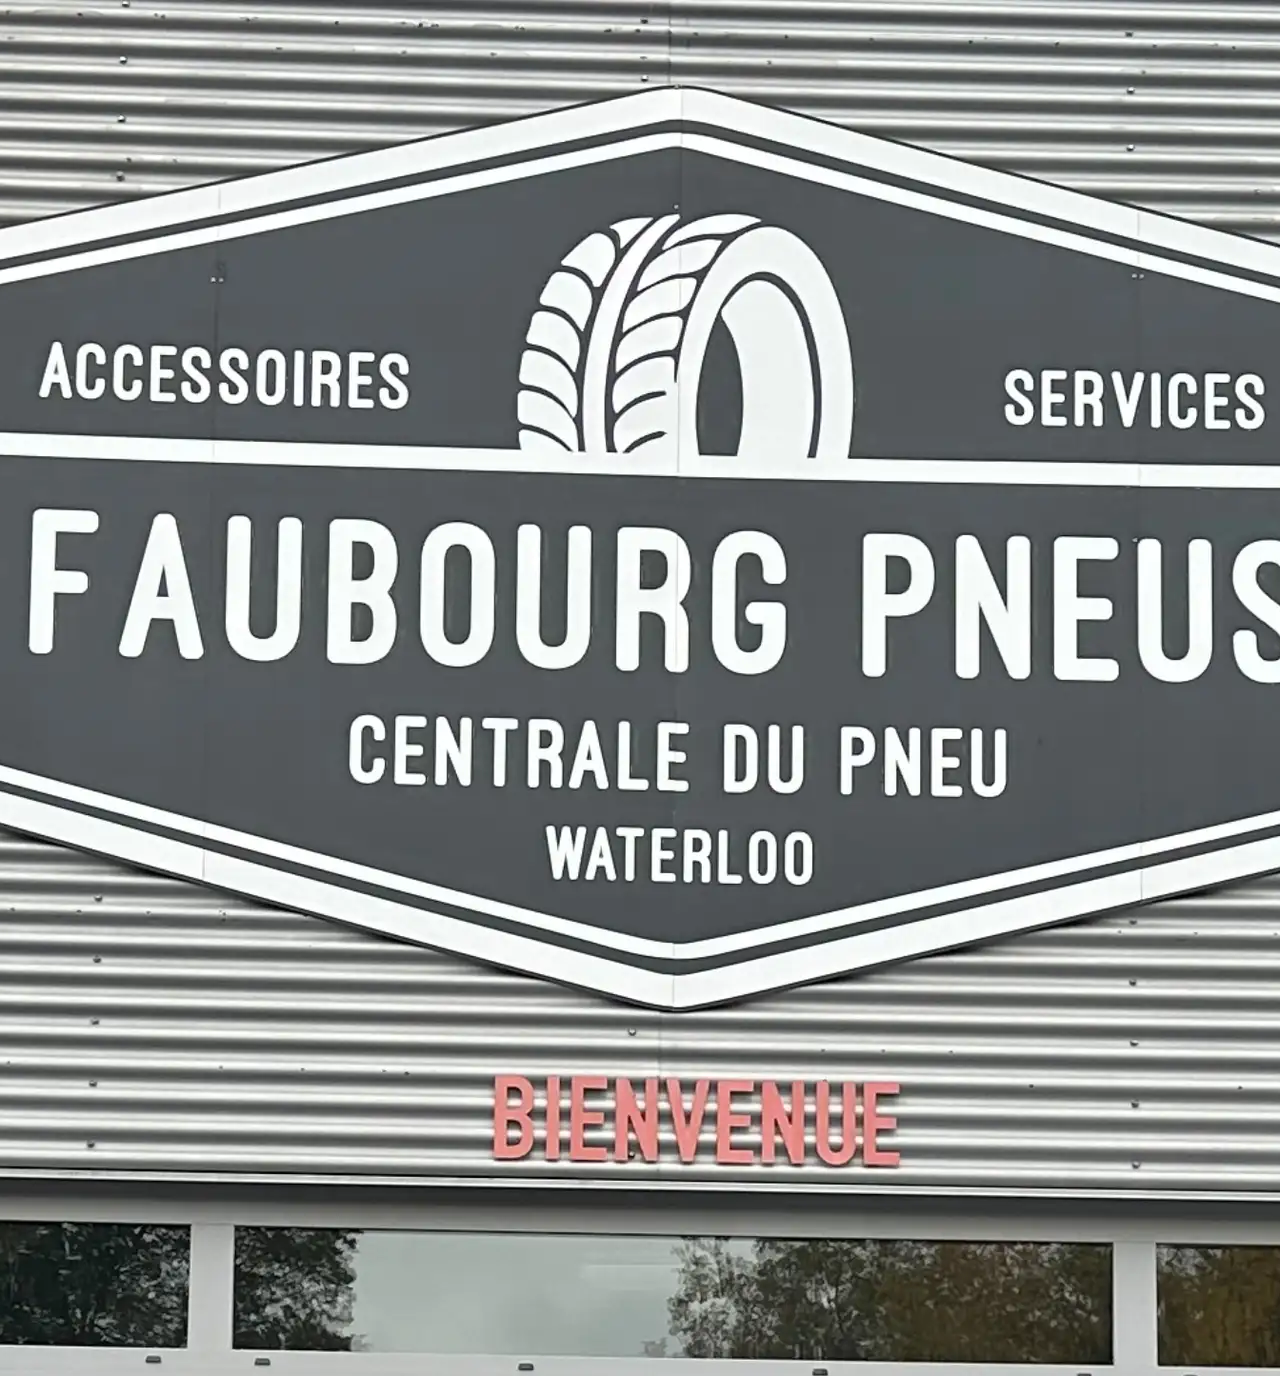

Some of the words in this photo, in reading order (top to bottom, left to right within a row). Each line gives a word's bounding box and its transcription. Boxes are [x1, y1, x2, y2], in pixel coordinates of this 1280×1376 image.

[39, 342, 410, 410] ACCESSOIRES
[1004, 369, 1265, 430] SERVICES
[28, 508, 787, 676] FAUBOURG
[349, 714, 690, 792] CENTRALE
[723, 723, 804, 794] DU
[840, 726, 1007, 798] PNEU
[545, 825, 813, 886] WATERLOO
[493, 1075, 900, 1166] BIENVENUE
